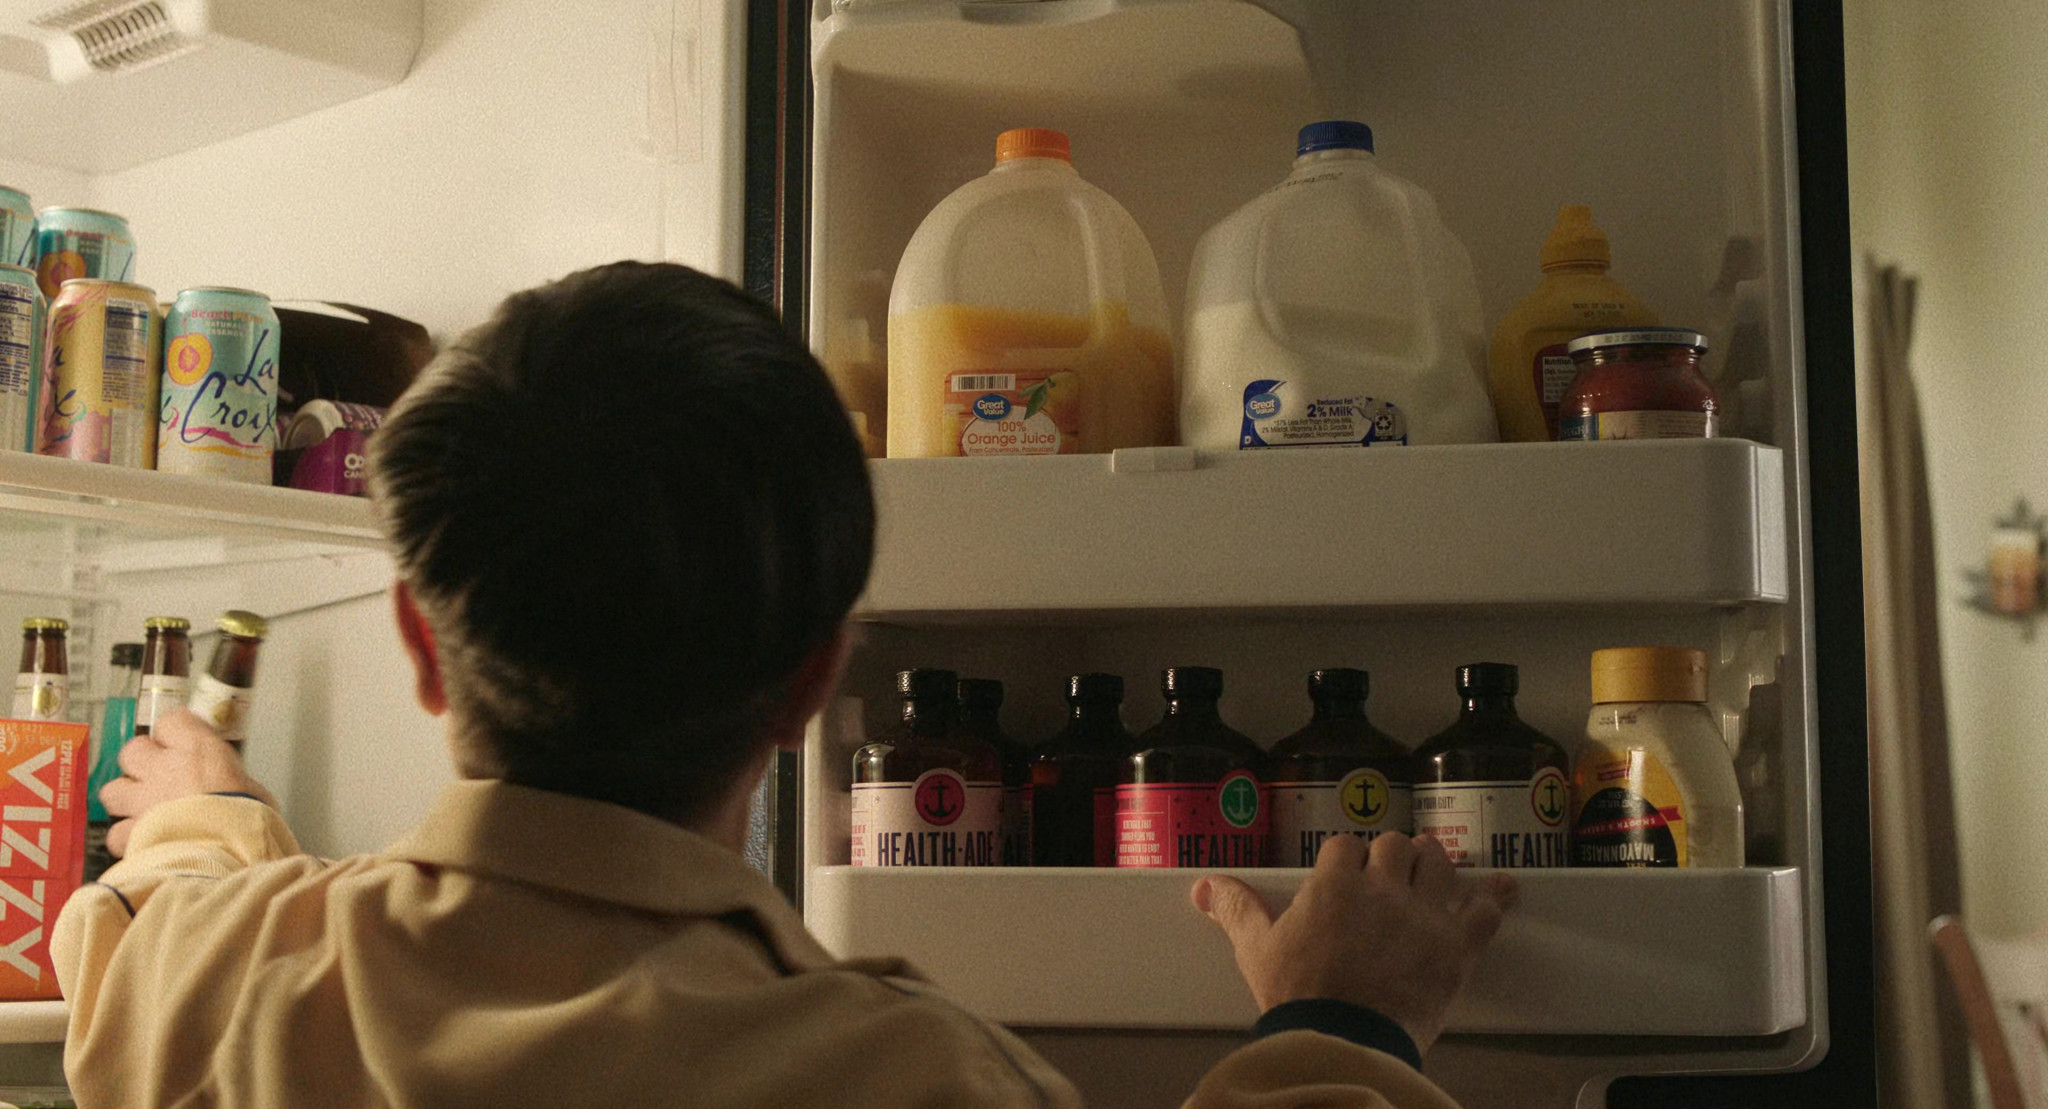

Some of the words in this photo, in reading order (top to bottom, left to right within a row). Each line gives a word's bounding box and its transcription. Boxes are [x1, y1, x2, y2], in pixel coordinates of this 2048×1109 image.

[191, 309, 231, 320] Beach
[234, 329, 274, 396] La
[181, 371, 277, 443] Croix
[976, 399, 1005, 411] Great
[1250, 398, 1276, 411] Great
[1256, 407, 1276, 415] Value
[1307, 404, 1327, 418] 2%
[1329, 406, 1353, 417] Milk
[983, 408, 1005, 416] Value
[997, 421, 1027, 433] 100%
[967, 433, 1017, 447] Orange
[1020, 432, 1056, 444] Juice
[1580, 843, 1655, 862] MAYONNAISE
[0, 746, 56, 982] VIZZY
